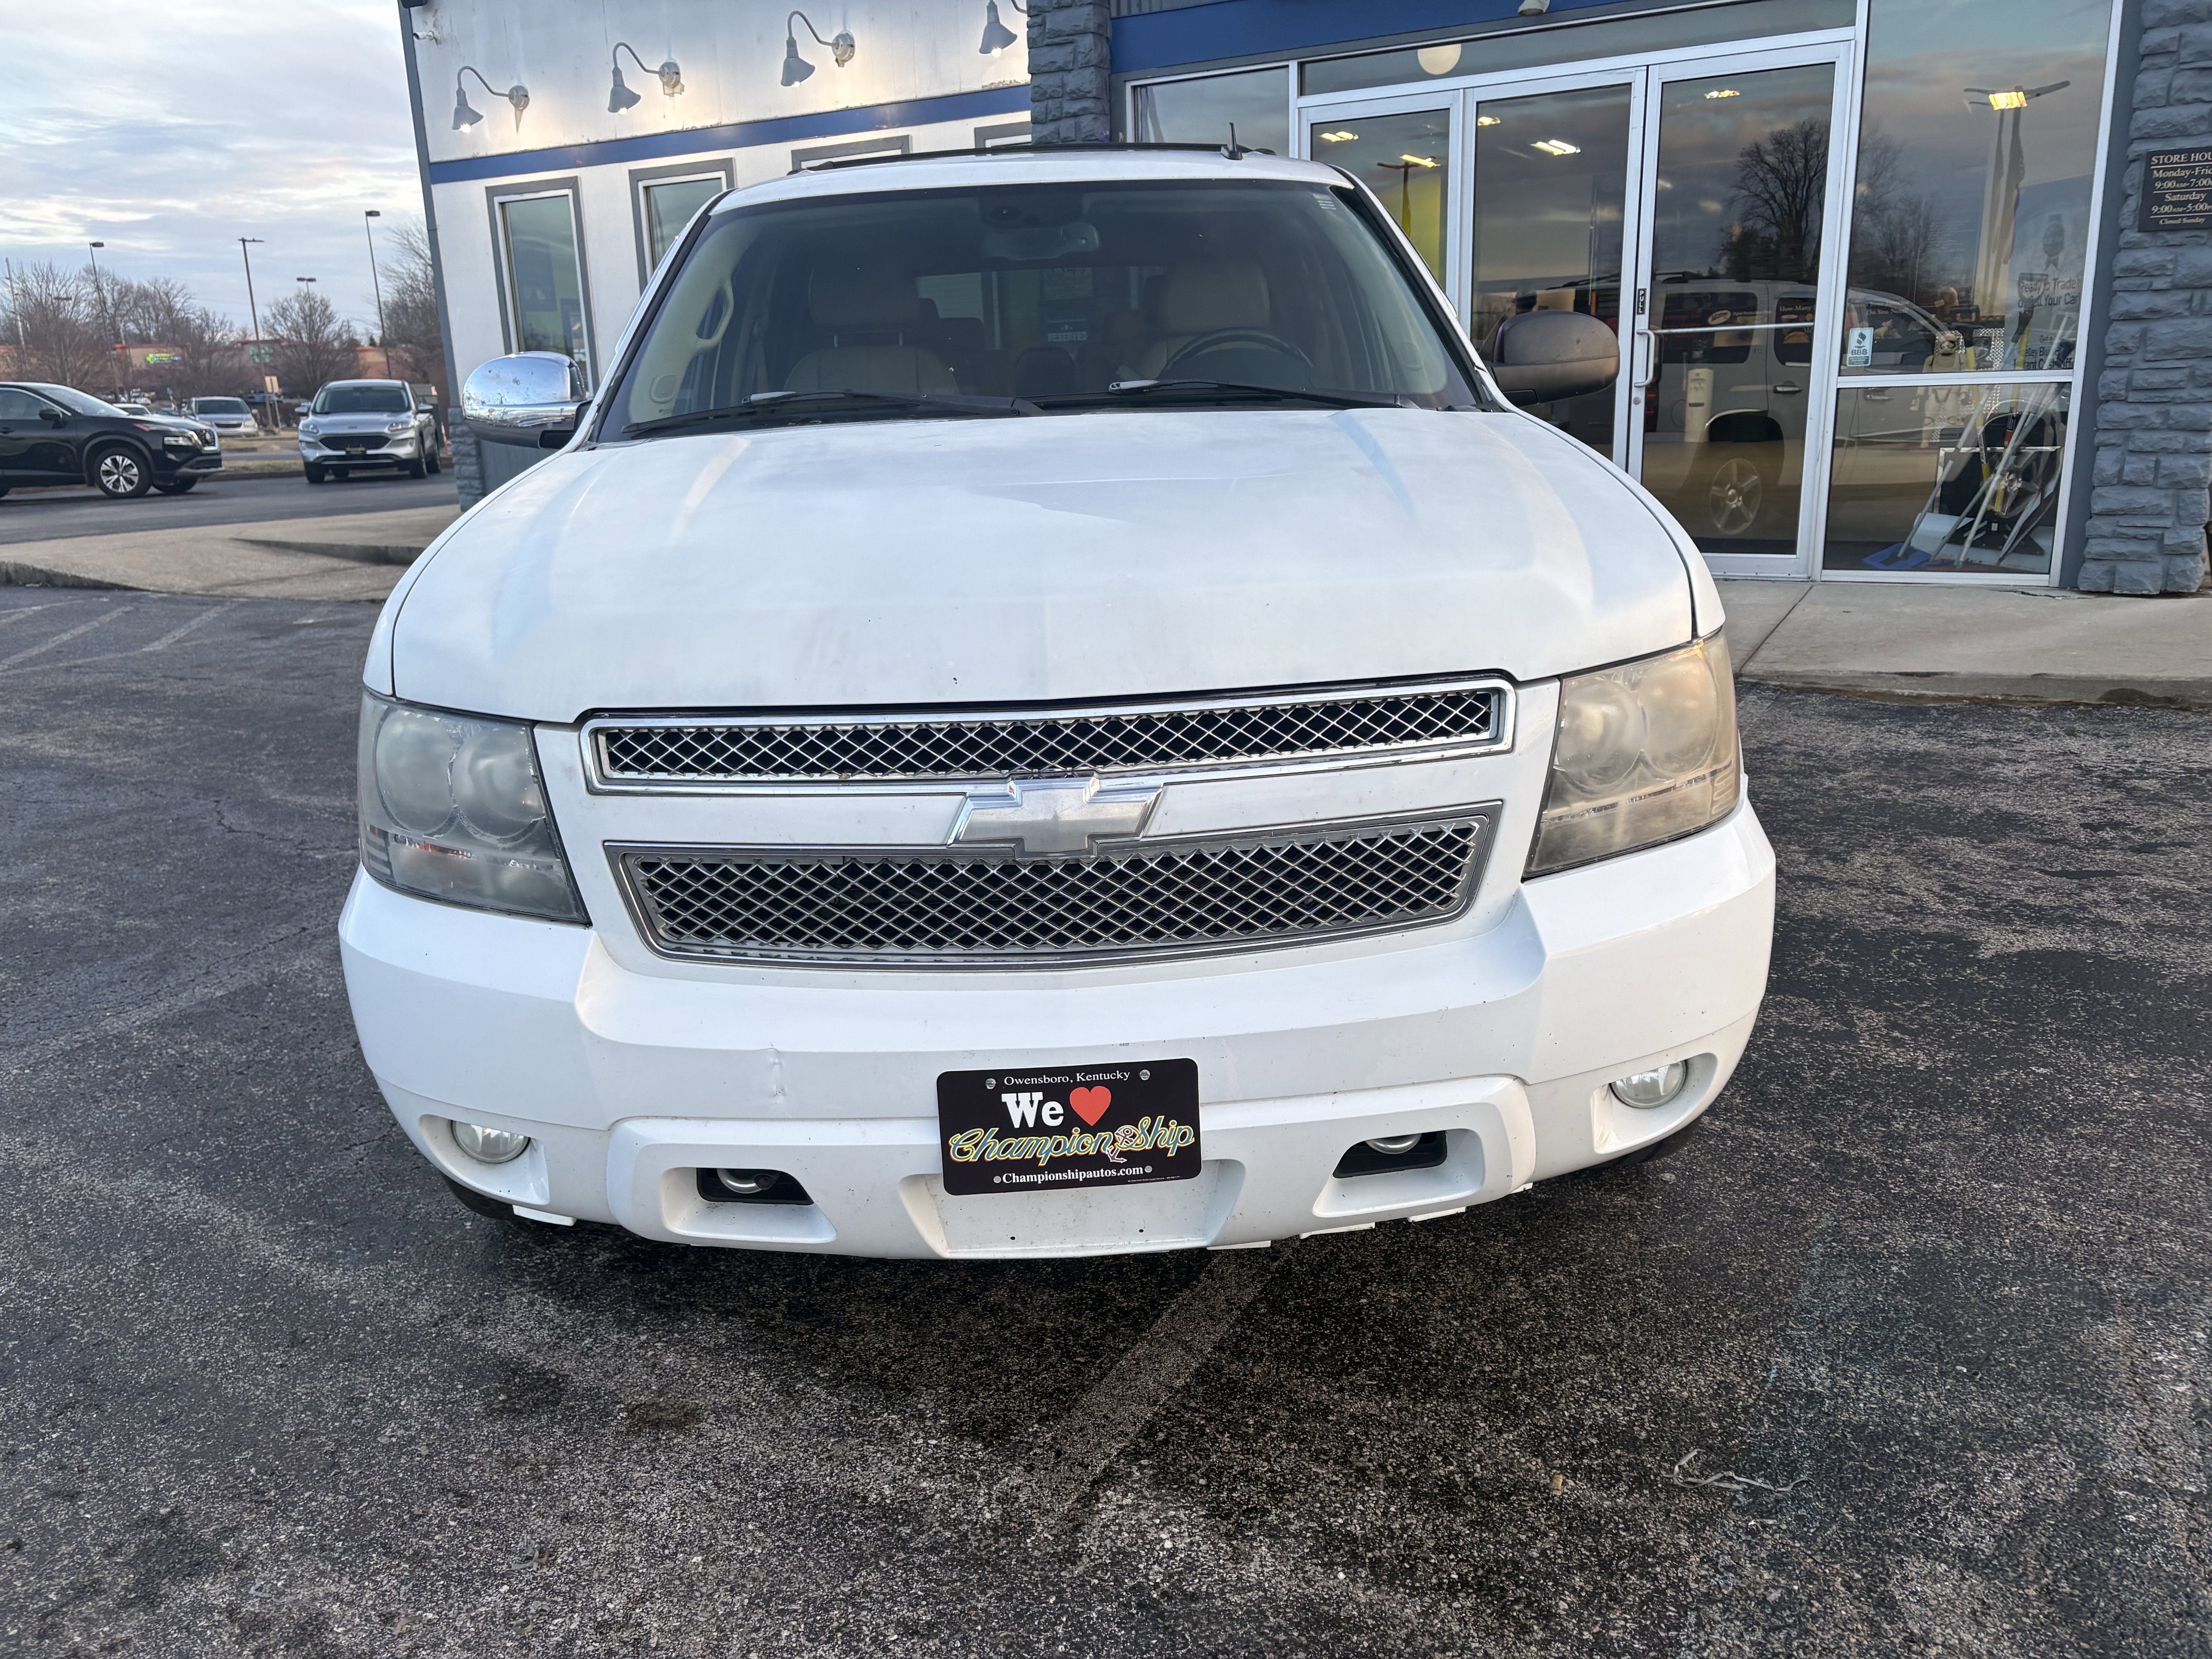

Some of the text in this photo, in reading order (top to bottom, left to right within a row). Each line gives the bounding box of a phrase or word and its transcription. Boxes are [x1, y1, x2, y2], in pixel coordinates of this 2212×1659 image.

[2151, 154, 2188, 165] STORE
[2164, 191, 2207, 202] Saturday
[2044, 294, 2063, 307] Your
[1004, 1070, 1130, 1085] Owensboro, Kentucky
[1001, 1092, 1064, 1128] We
[1003, 1166, 1144, 1184] Championshipautos.com
